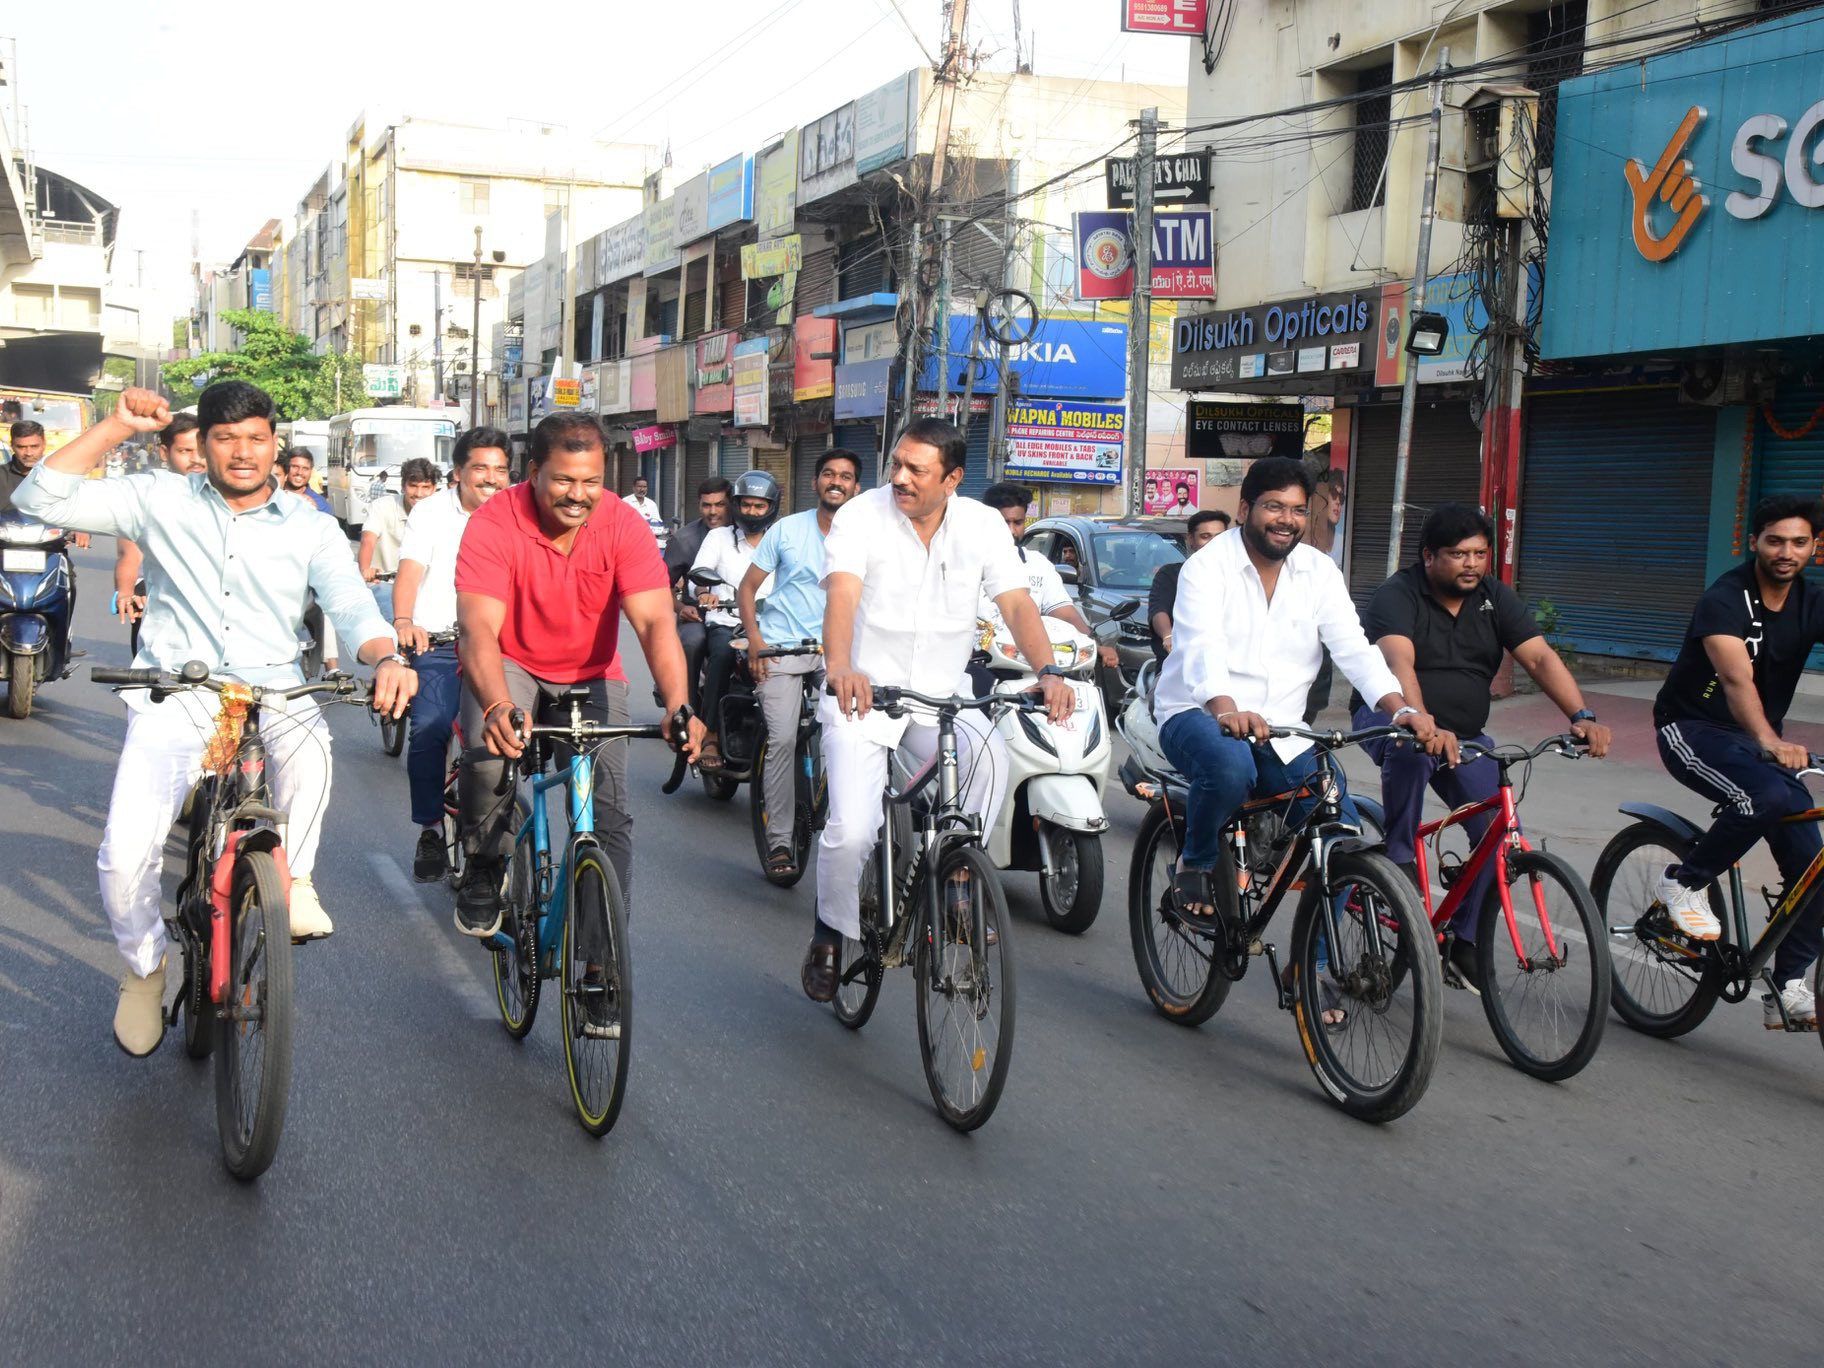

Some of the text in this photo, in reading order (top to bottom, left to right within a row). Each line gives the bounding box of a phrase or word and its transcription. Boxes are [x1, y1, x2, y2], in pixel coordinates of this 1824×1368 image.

[1174, 158, 1202, 183] CHAI
[1177, 294, 1368, 353] Dilsukh Opticals
[1332, 345, 1357, 356] CARRERA
[1195, 405, 1300, 418] DILSUKH OPTICALS
[1008, 408, 1124, 430] WAPNA MOBILES
[1195, 420, 1299, 432] EYE CONTACT LENSES
[1045, 443, 1073, 451] MOBILES
[1079, 445, 1096, 453] TABS
[1027, 450, 1047, 458] SKINS
[1048, 451, 1068, 459] FRONT
[1076, 453, 1093, 461] BACK
[1051, 471, 1073, 479] Available
[1703, 680, 1717, 699] RUN
